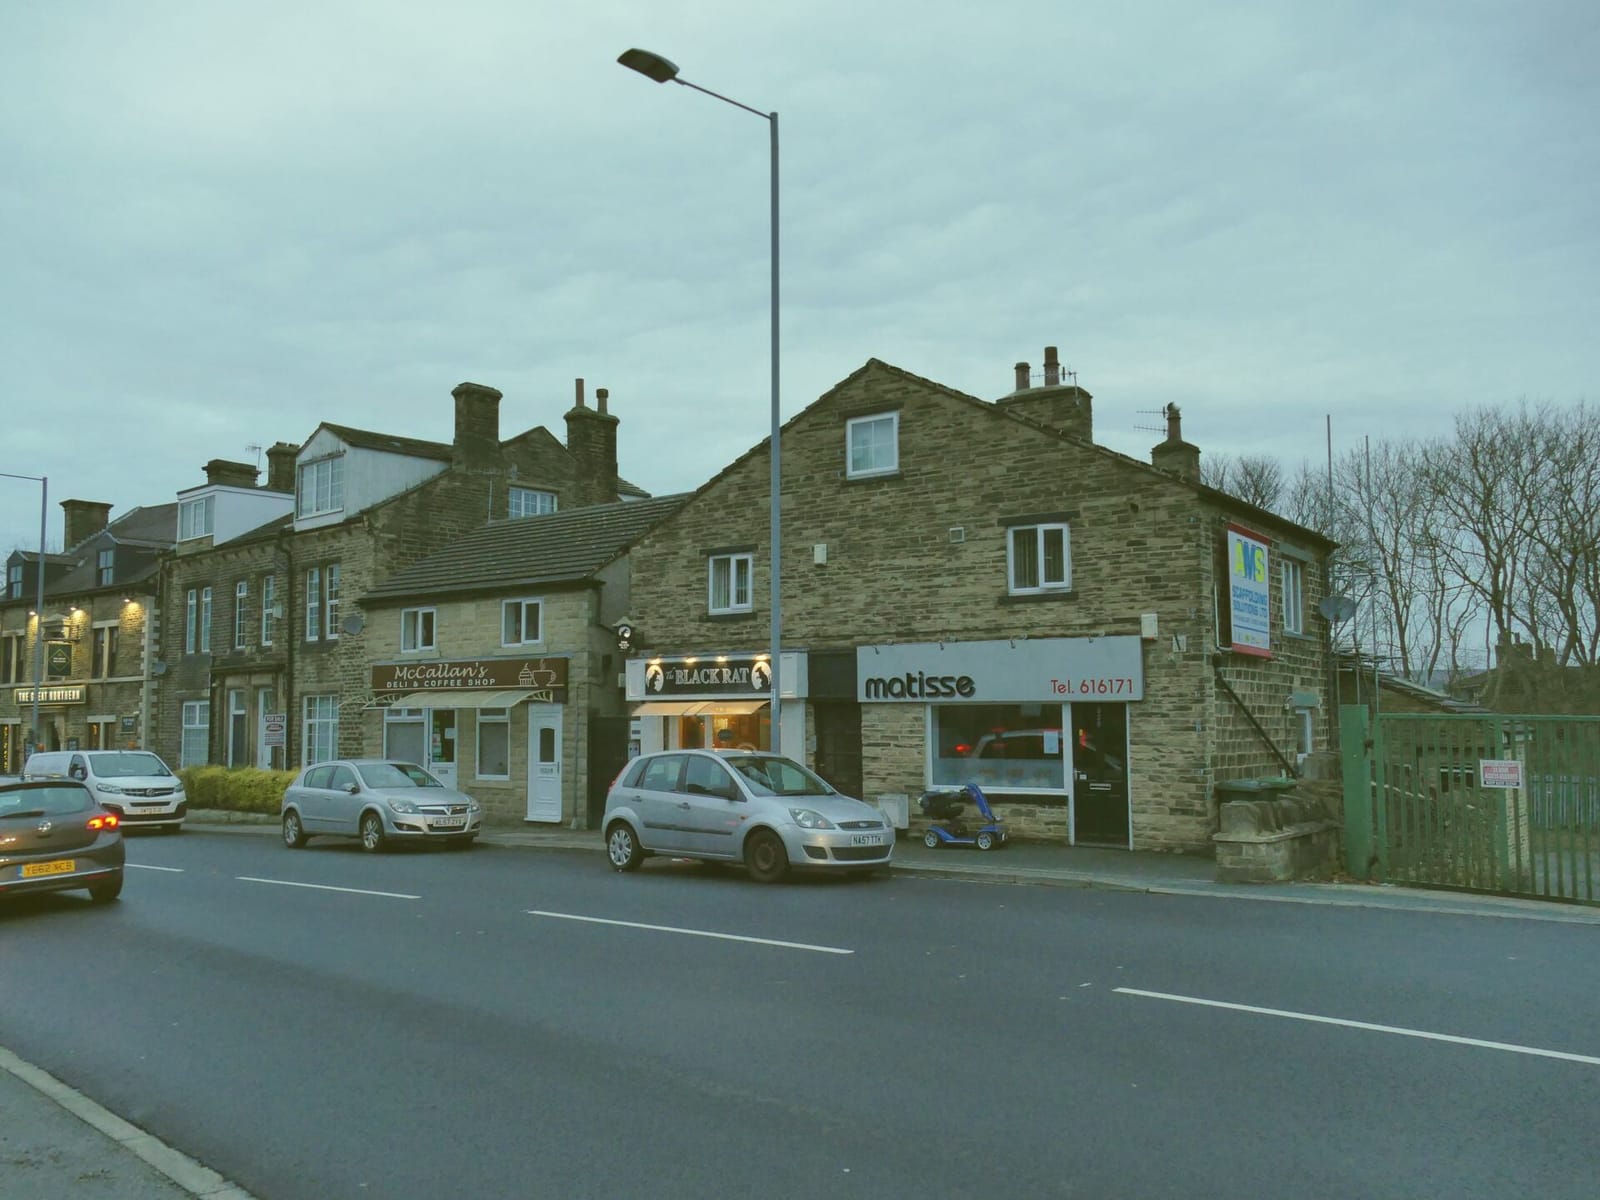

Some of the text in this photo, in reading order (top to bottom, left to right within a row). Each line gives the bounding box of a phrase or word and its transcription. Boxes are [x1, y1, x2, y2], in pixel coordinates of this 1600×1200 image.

[1235, 539, 1266, 583] AMS
[394, 662, 488, 680] McCallan's
[675, 669, 721, 685] BLACK
[722, 667, 749, 684] RAT
[467, 678, 496, 686] SHOP
[865, 670, 976, 699] matisse
[1051, 678, 1133, 694] Tel. 616171
[19, 690, 80, 702] THE GEAT NORTHERN
